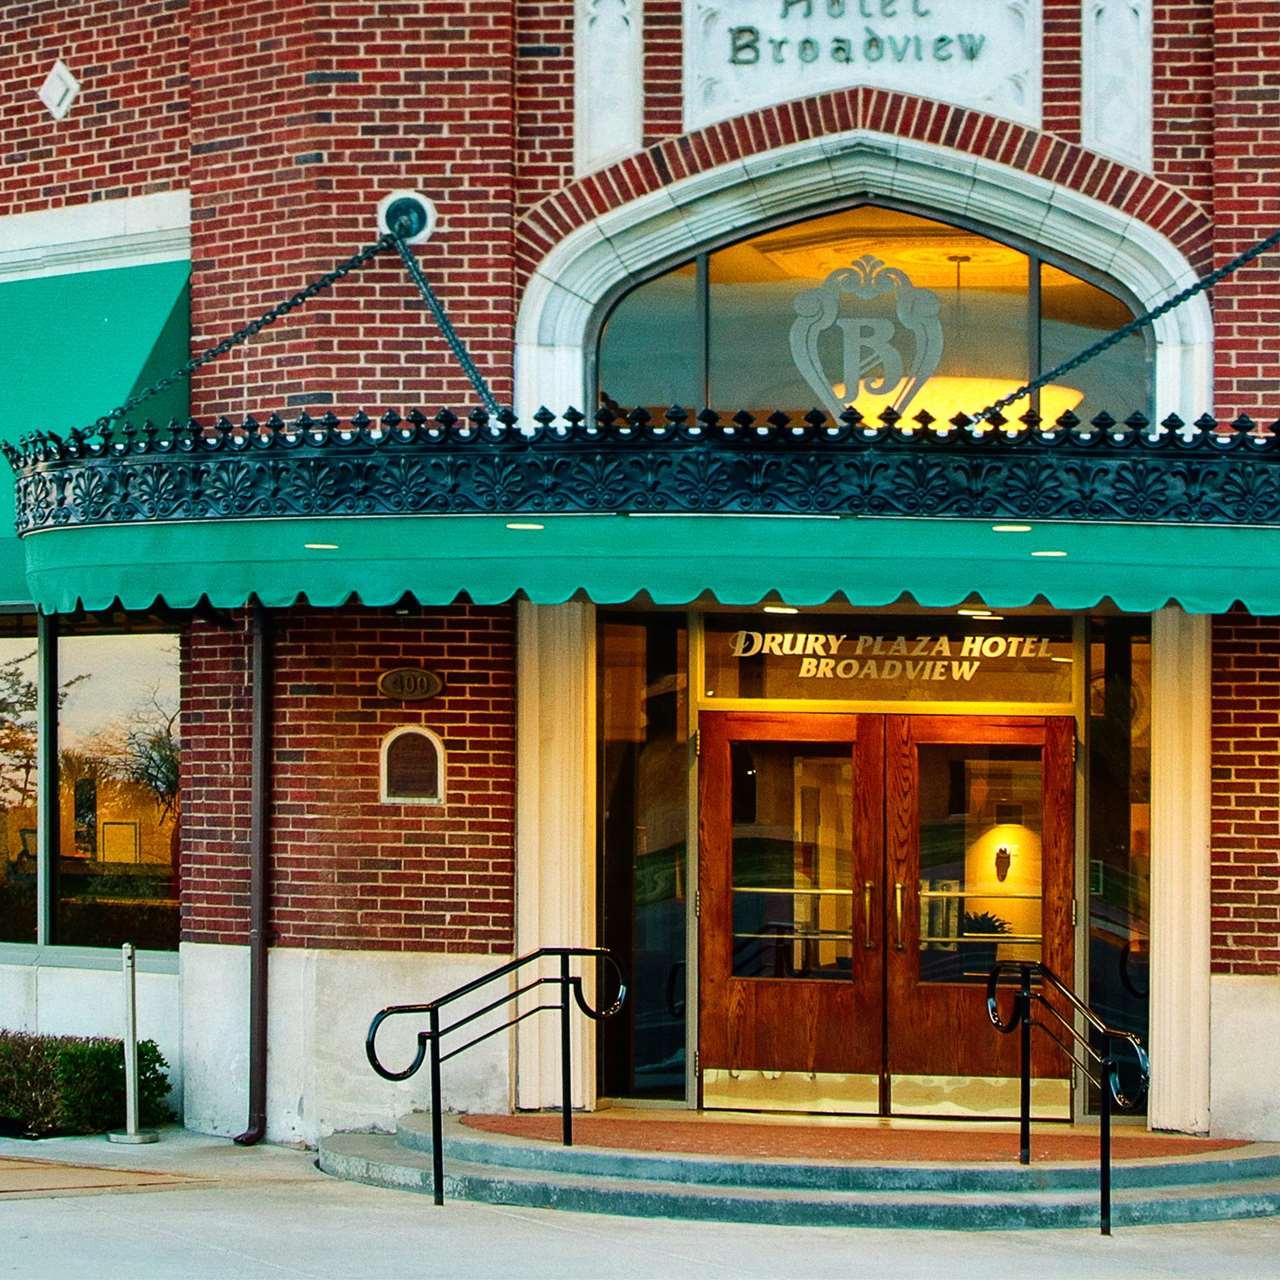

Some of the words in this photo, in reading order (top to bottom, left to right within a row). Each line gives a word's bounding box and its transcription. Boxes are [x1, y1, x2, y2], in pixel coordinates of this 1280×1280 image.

[728, 25, 986, 65] Broadview
[834, 318, 903, 405] B
[728, 630, 847, 657] DRURY
[854, 635, 952, 657] PLAZA
[959, 636, 1054, 658] HOTEL
[797, 657, 981, 681] BROADVIEW
